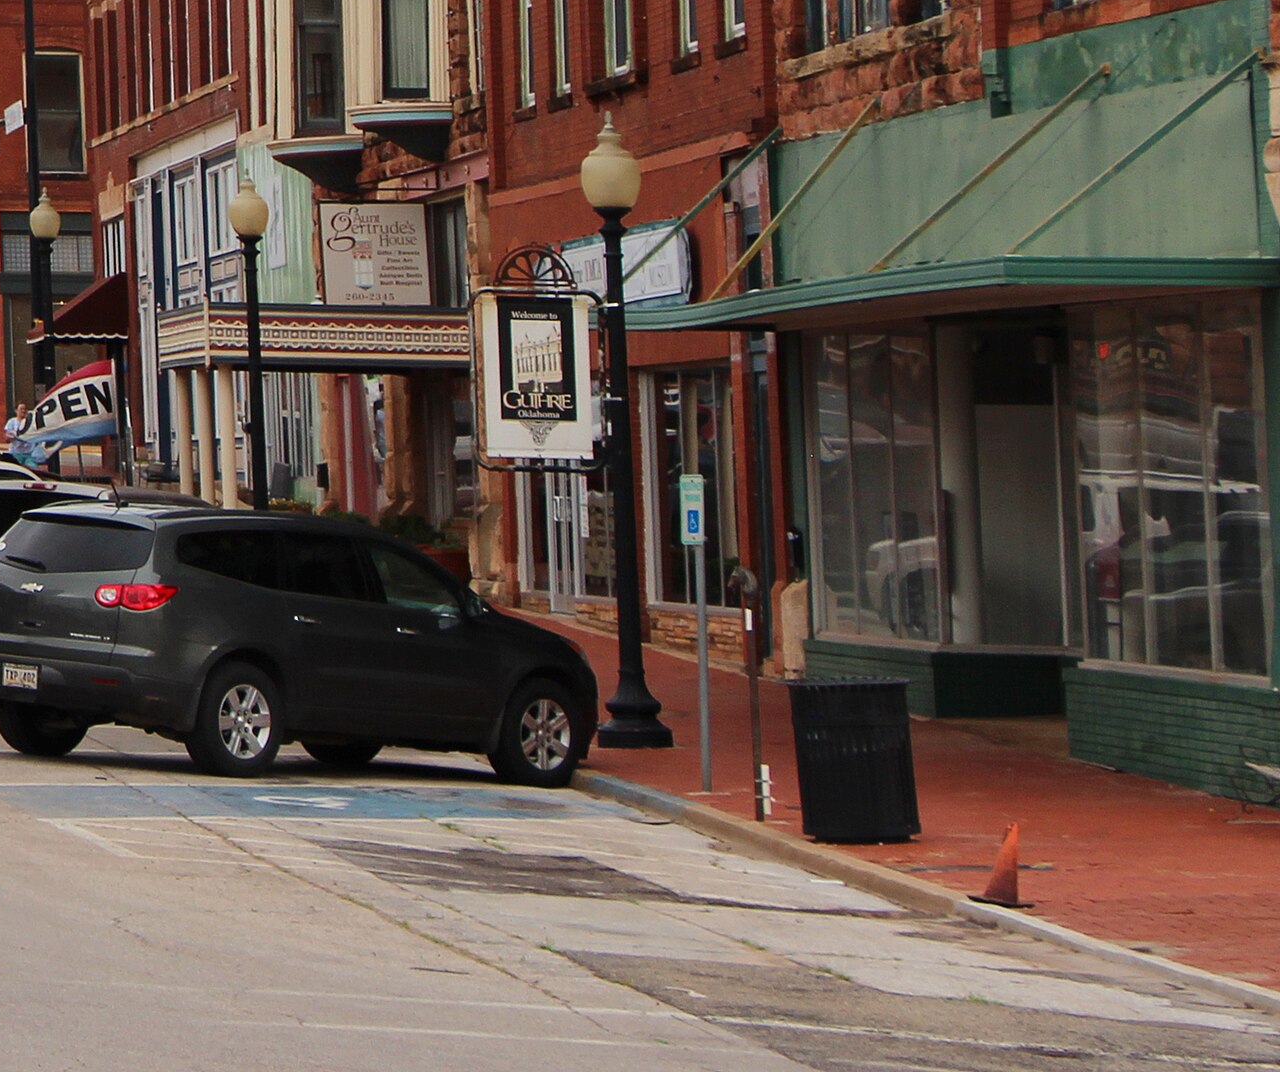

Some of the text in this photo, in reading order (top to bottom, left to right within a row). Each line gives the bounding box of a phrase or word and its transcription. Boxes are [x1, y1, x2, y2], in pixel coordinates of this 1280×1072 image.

[510, 311, 559, 320] Welcome to
[518, 409, 560, 419] Oklahoma
[5, 669, 19, 680] TXP
